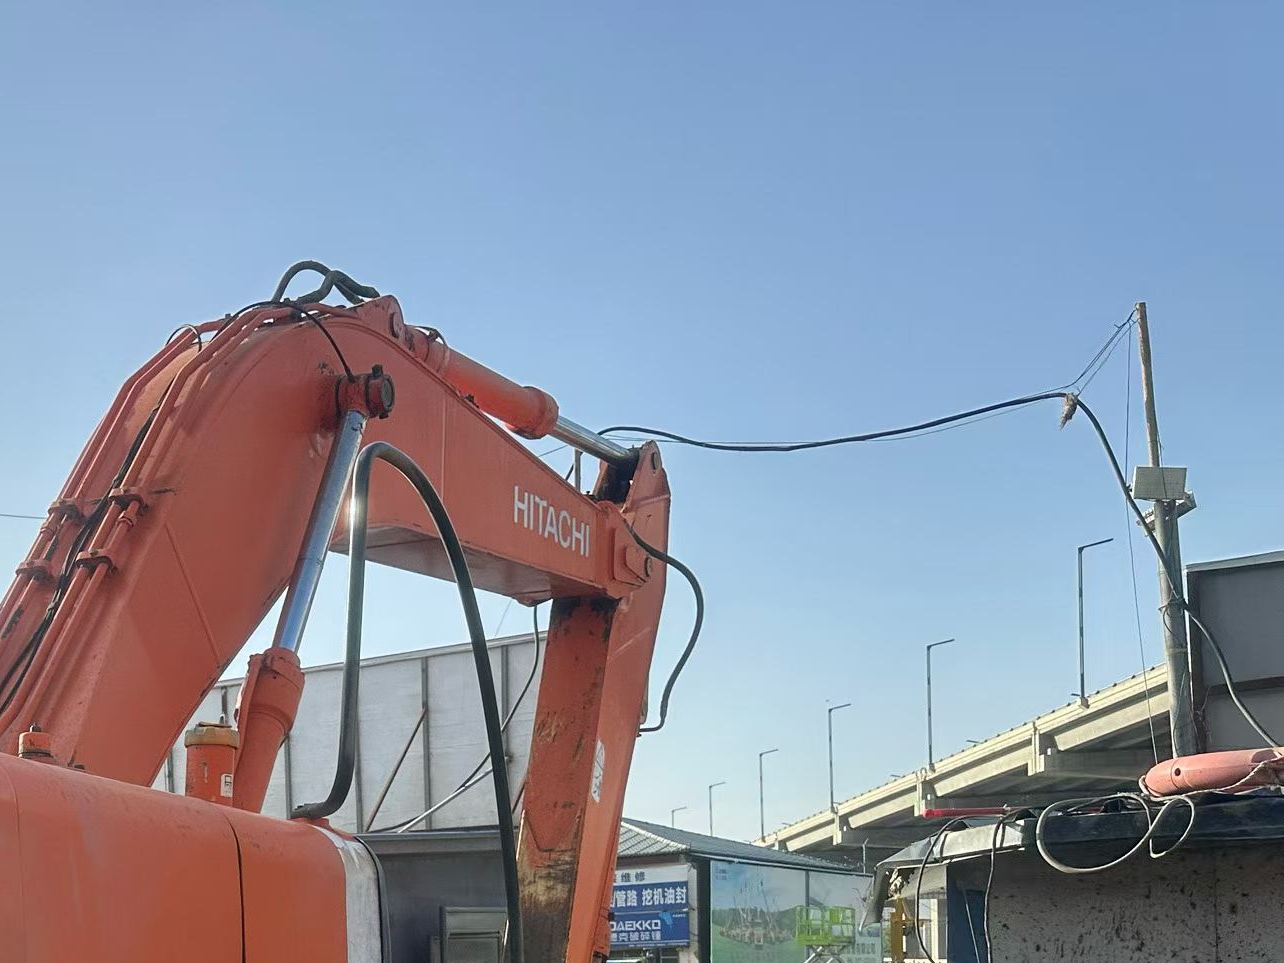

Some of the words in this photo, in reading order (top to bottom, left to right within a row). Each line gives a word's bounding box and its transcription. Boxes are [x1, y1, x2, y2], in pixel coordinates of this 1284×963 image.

[513, 485, 590, 558] HITACHI
[614, 871, 646, 883] 维修
[642, 886, 687, 906] 挖机油封
